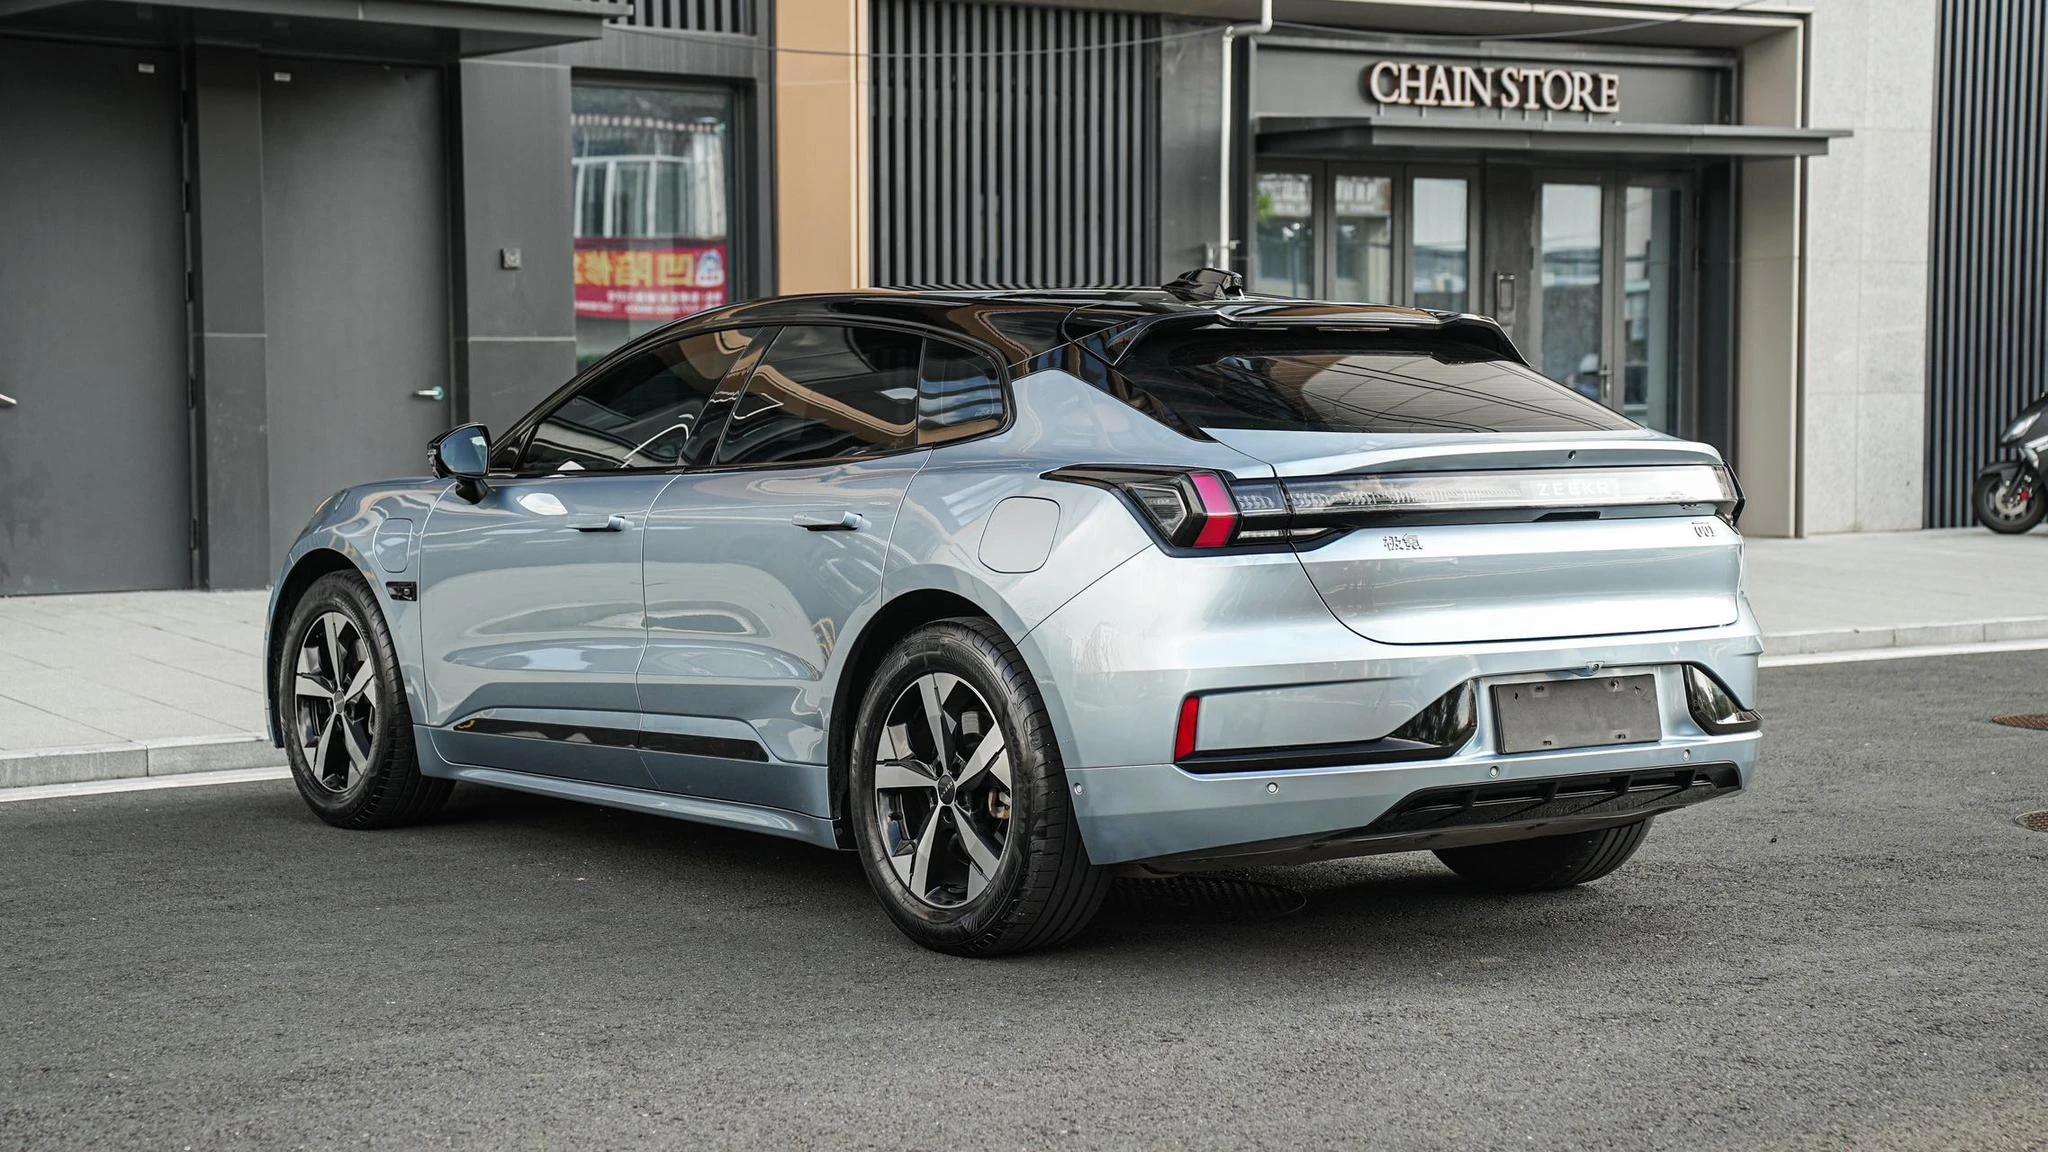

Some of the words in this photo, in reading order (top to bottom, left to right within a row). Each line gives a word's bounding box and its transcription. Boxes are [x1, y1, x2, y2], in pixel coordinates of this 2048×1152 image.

[1369, 61, 1496, 107] CHAIN
[1501, 67, 1620, 112] STORE
[1536, 480, 1611, 497] ZEEKR
